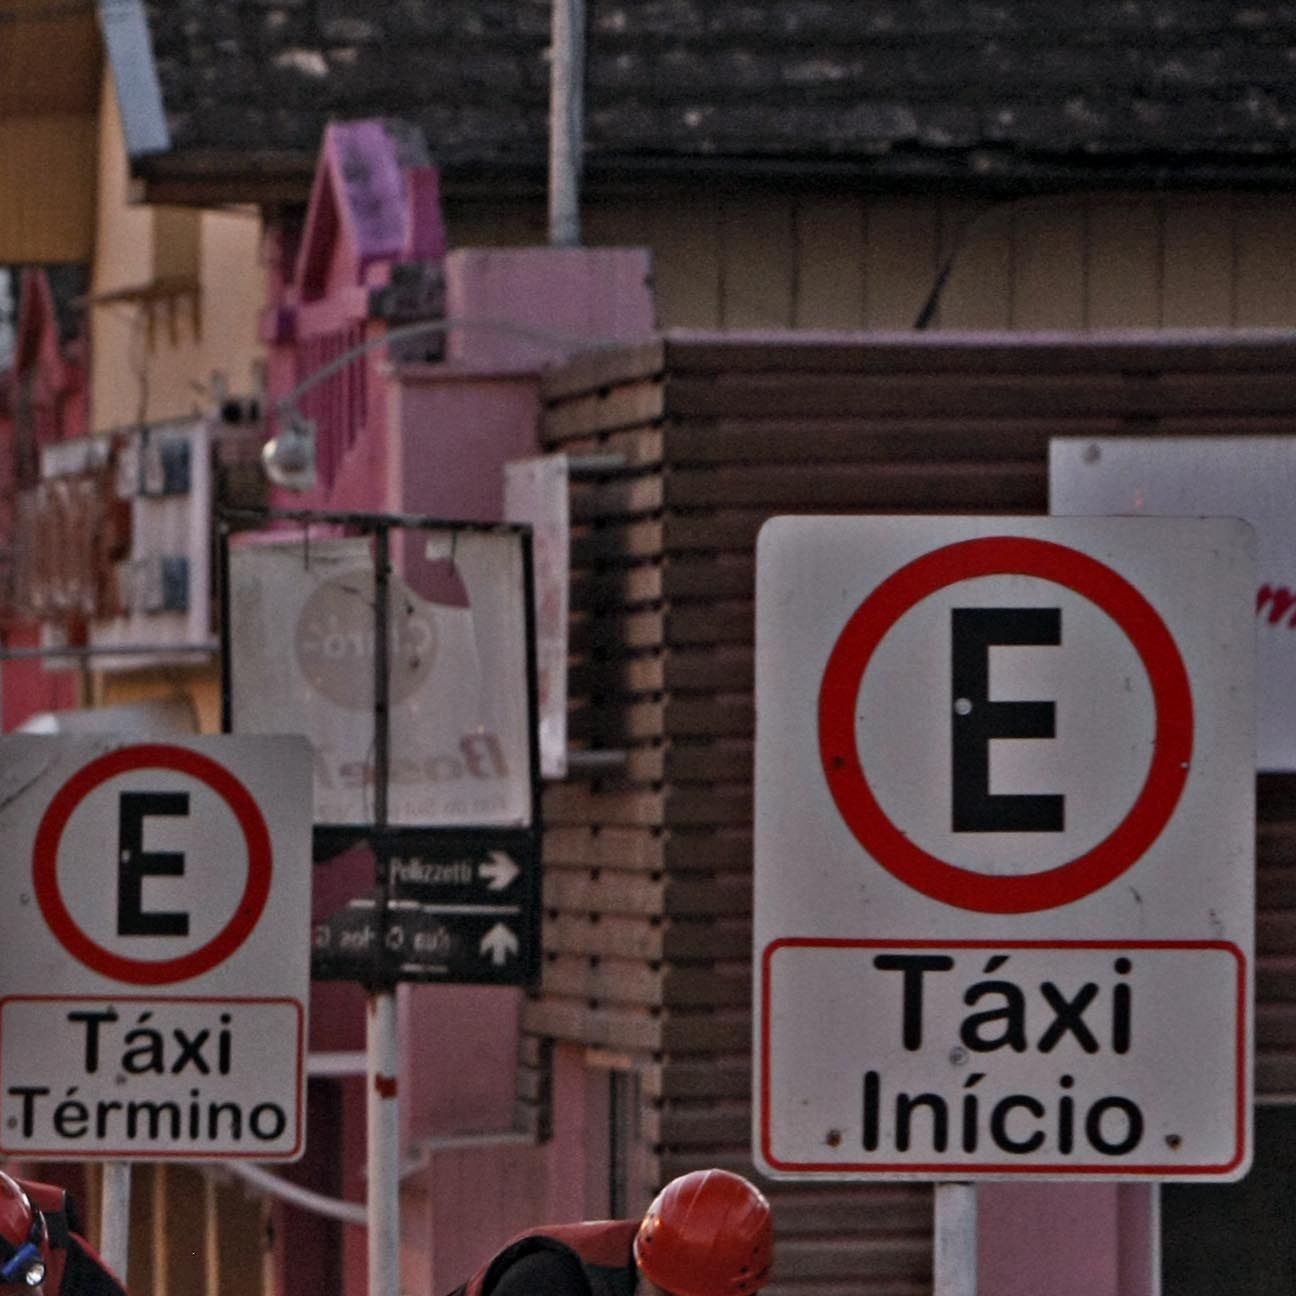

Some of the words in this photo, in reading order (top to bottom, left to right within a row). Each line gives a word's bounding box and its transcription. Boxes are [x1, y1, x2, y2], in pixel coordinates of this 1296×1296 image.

[950, 606, 1065, 833] E
[116, 791, 189, 936] E
[68, 1007, 232, 1076] Táxi
[873, 954, 1133, 1055] Táxi
[8, 1086, 287, 1143] Término
[862, 1070, 1145, 1156] Início
